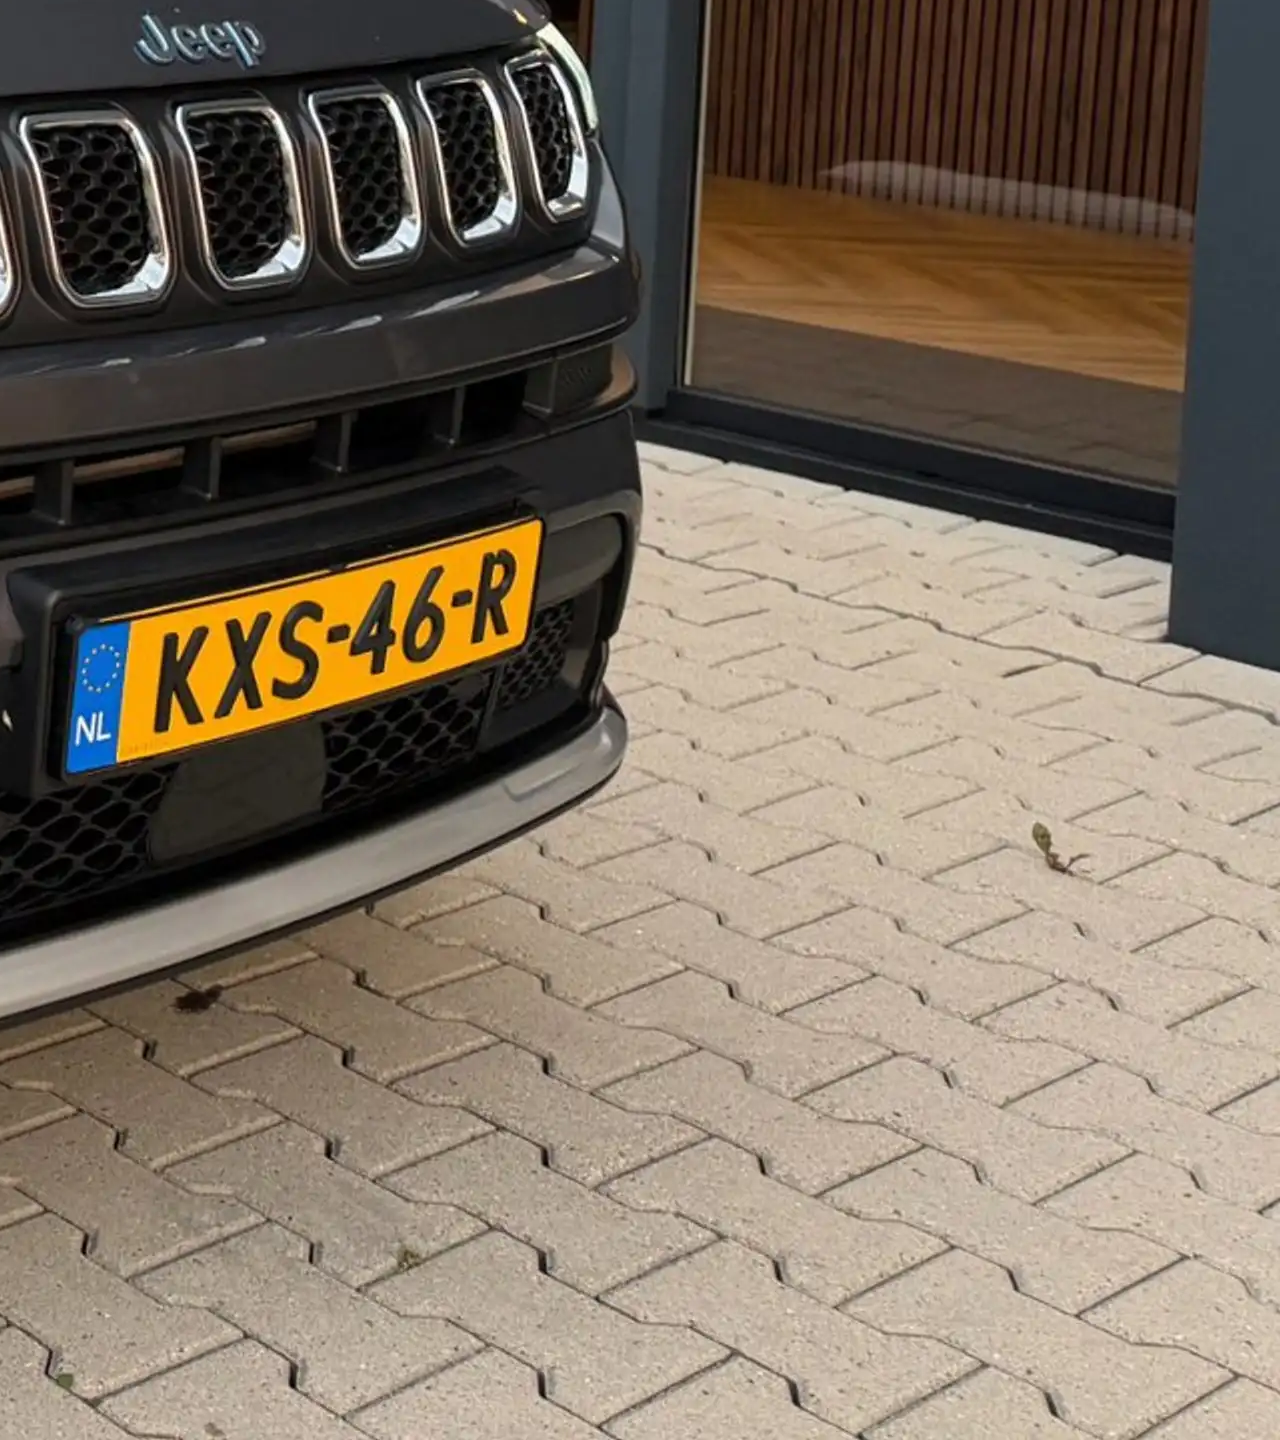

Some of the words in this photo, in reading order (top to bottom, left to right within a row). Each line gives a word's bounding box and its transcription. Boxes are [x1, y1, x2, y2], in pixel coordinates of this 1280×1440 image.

[133, 12, 267, 70] Jeep
[153, 548, 518, 733] KXS-46-R
[75, 711, 111, 746] NL
